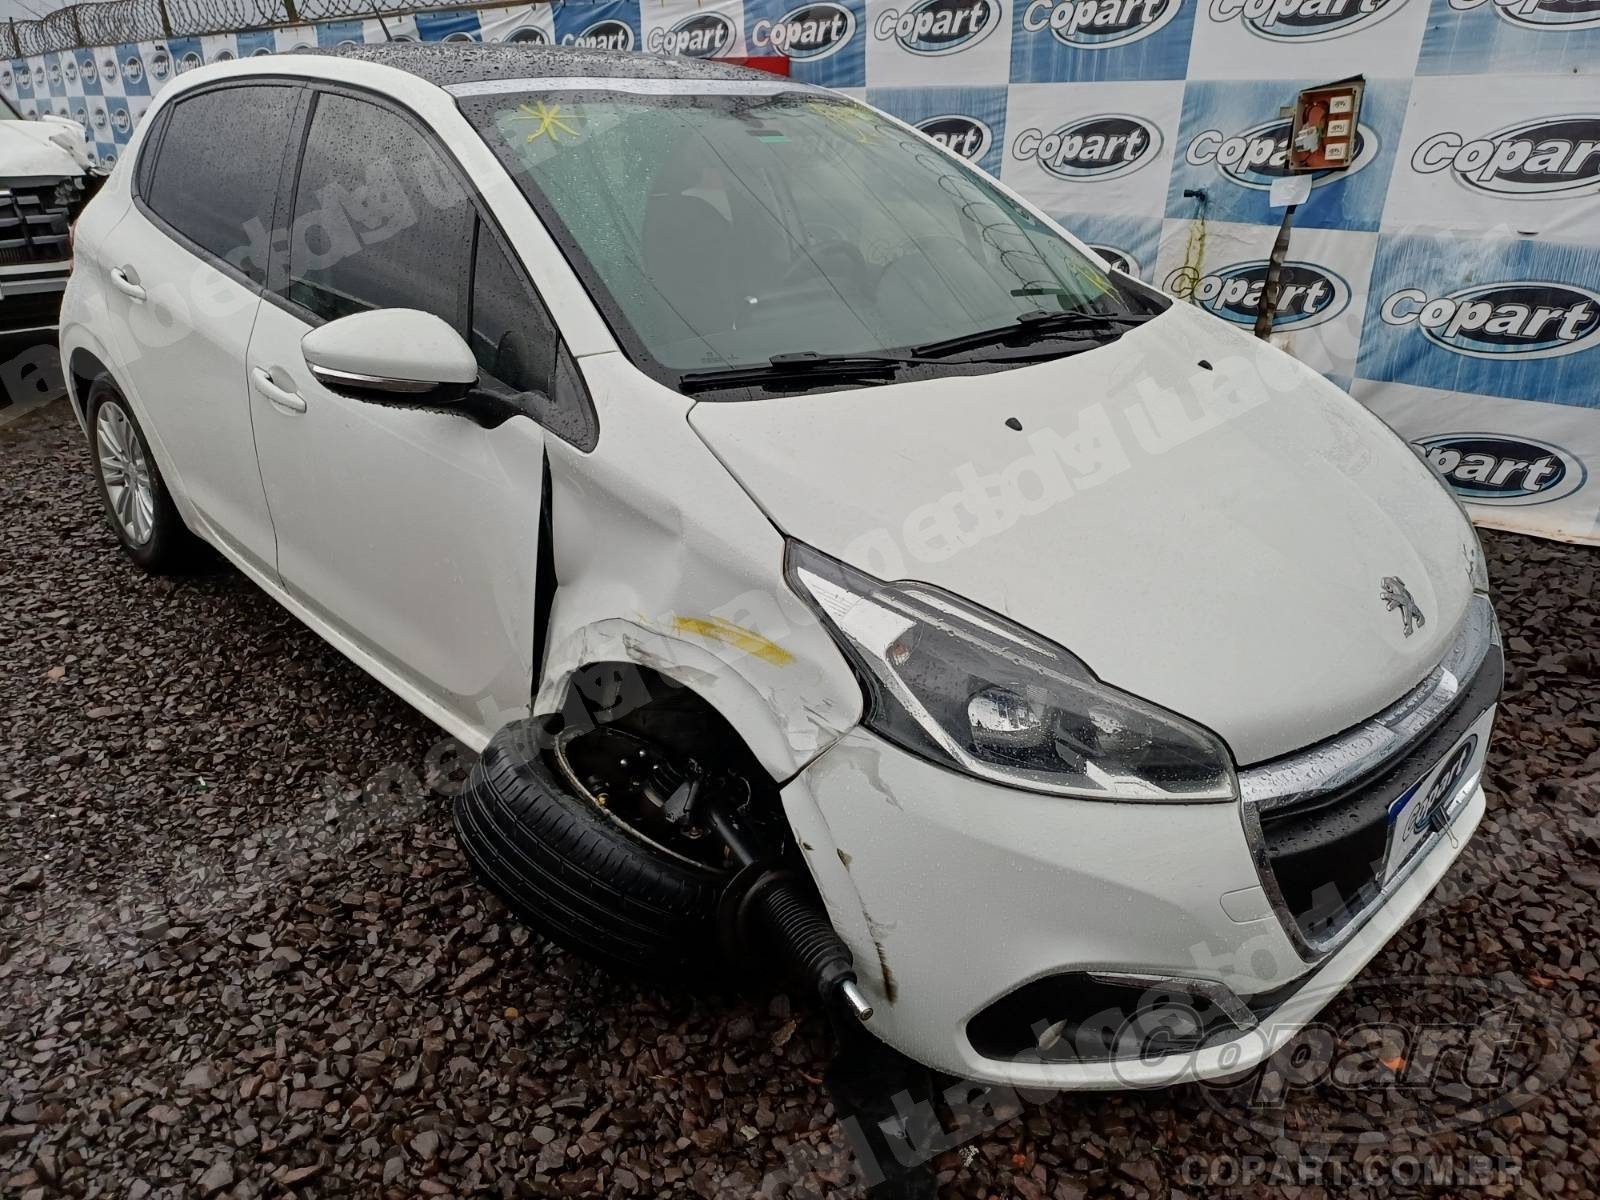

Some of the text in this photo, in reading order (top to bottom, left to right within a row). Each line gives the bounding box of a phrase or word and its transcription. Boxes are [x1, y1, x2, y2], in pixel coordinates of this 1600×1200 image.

[752, 17, 843, 51] Copart
[874, 3, 985, 44] Copart
[1023, 0, 1160, 36] Copart
[648, 25, 724, 54] Copart
[932, 128, 977, 157] art
[1012, 126, 1145, 168] Copart
[1185, 129, 1290, 175] Copa
[1411, 132, 1600, 182] Copar
[1380, 288, 1594, 341] Copart
[1412, 443, 1557, 492] part
